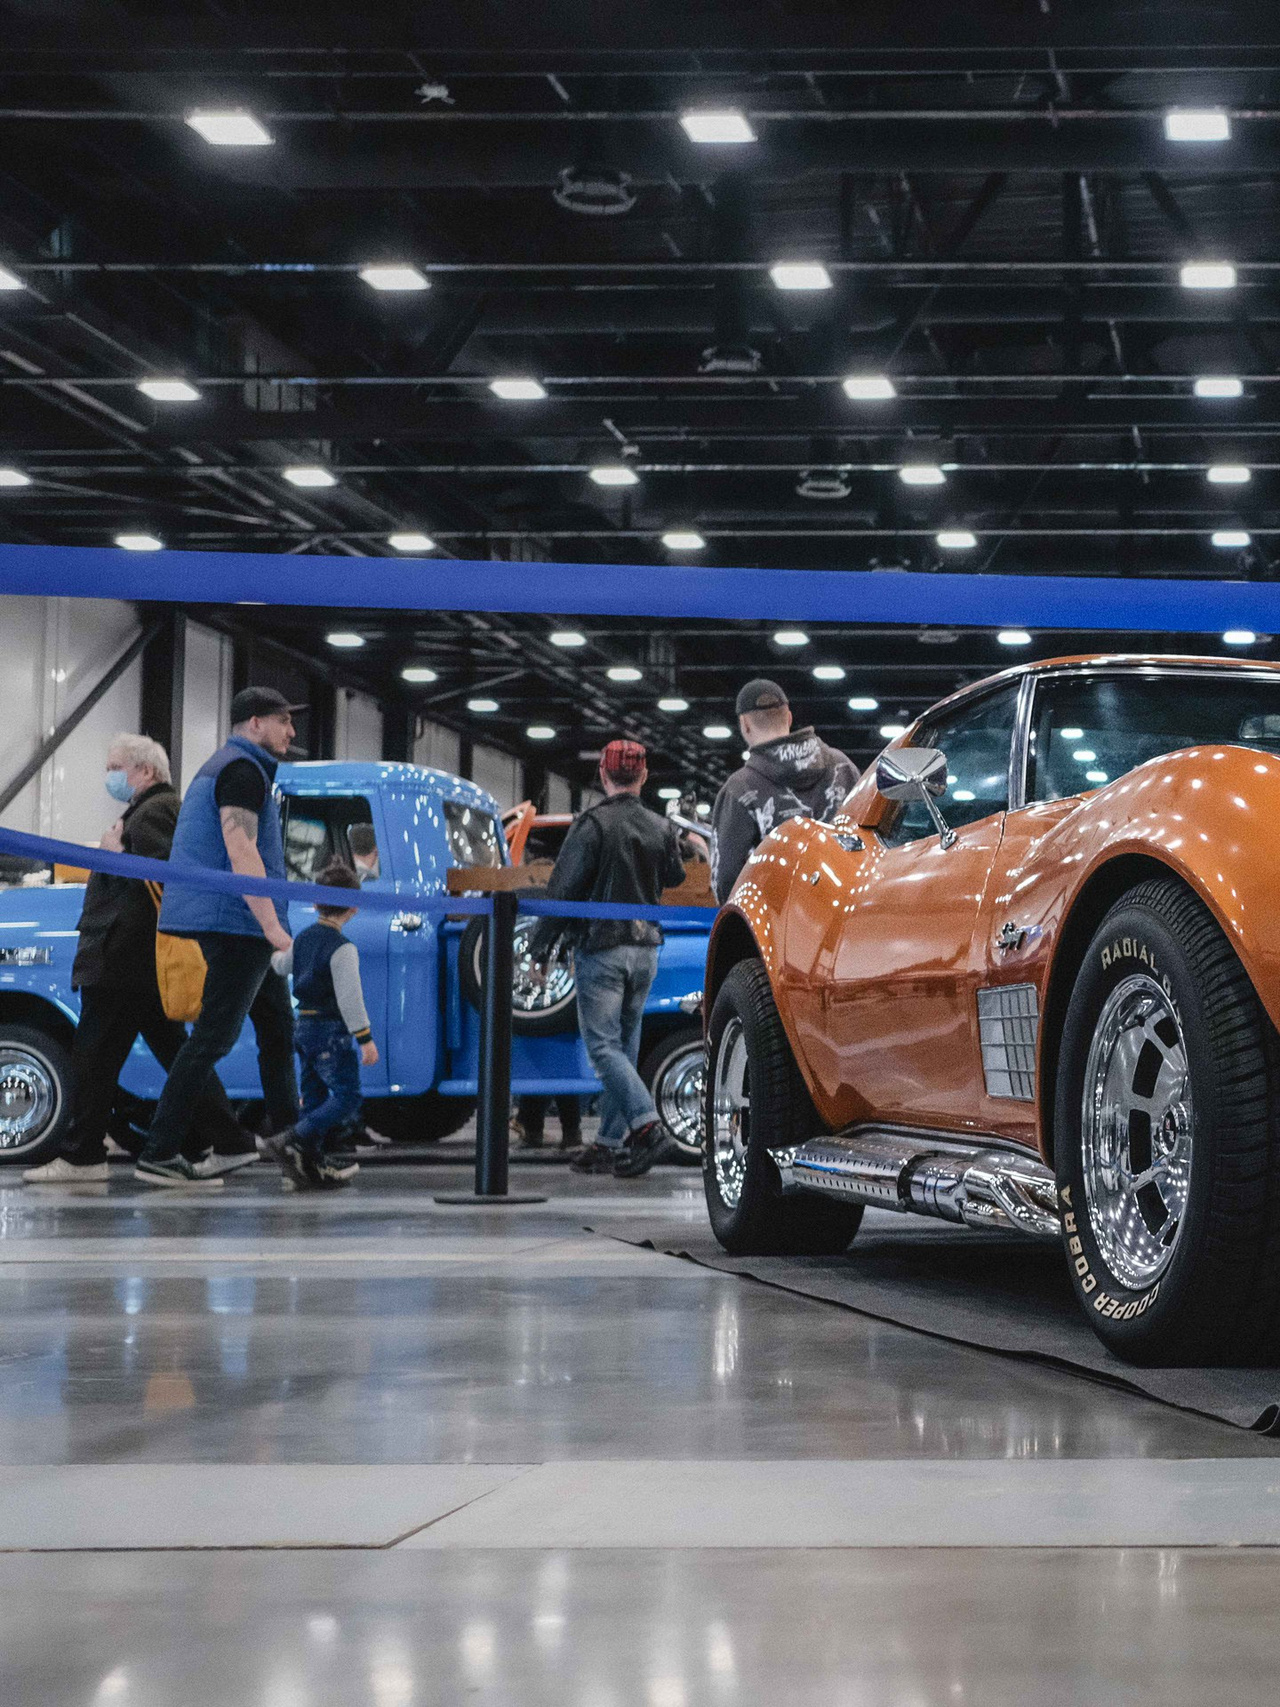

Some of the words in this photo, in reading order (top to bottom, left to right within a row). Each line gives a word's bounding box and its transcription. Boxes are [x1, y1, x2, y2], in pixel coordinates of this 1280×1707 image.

[1101, 937, 1159, 976] RADIAL
[1060, 1184, 1097, 1294] COBRA
[1093, 1281, 1161, 1320] COOPER
